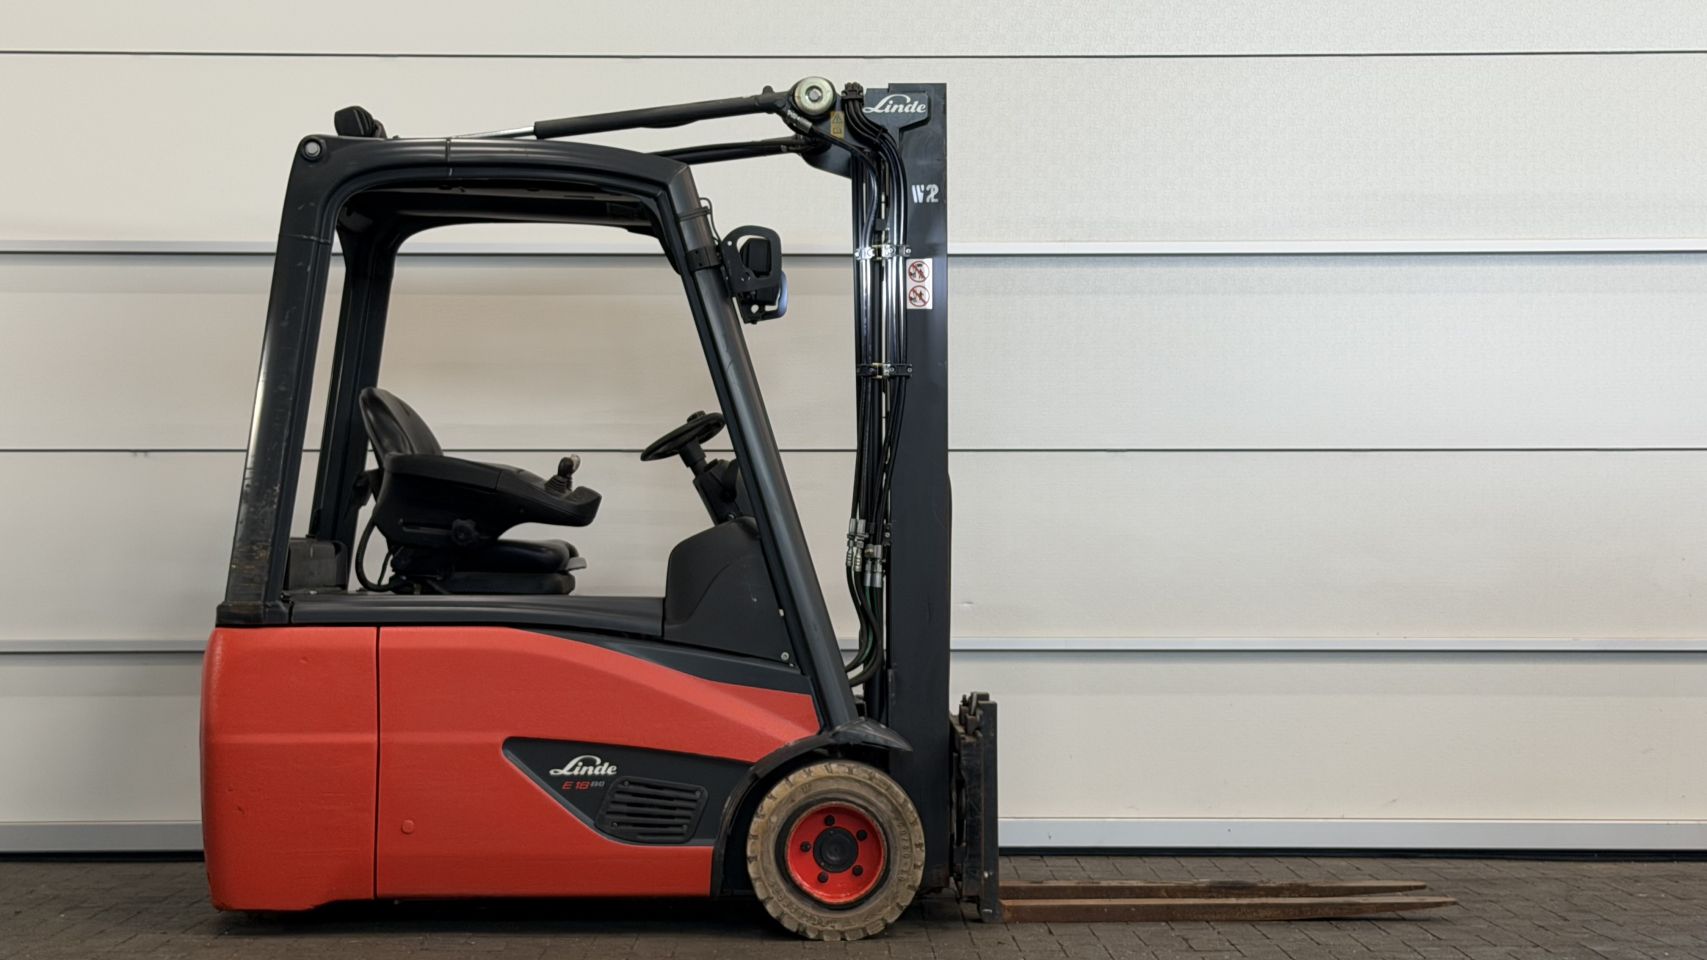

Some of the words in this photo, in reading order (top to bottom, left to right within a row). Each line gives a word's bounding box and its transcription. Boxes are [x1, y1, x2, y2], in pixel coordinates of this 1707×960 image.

[862, 94, 927, 113] Linde
[911, 184, 939, 203] W2
[549, 755, 618, 776] Linde
[562, 781, 574, 790] E
